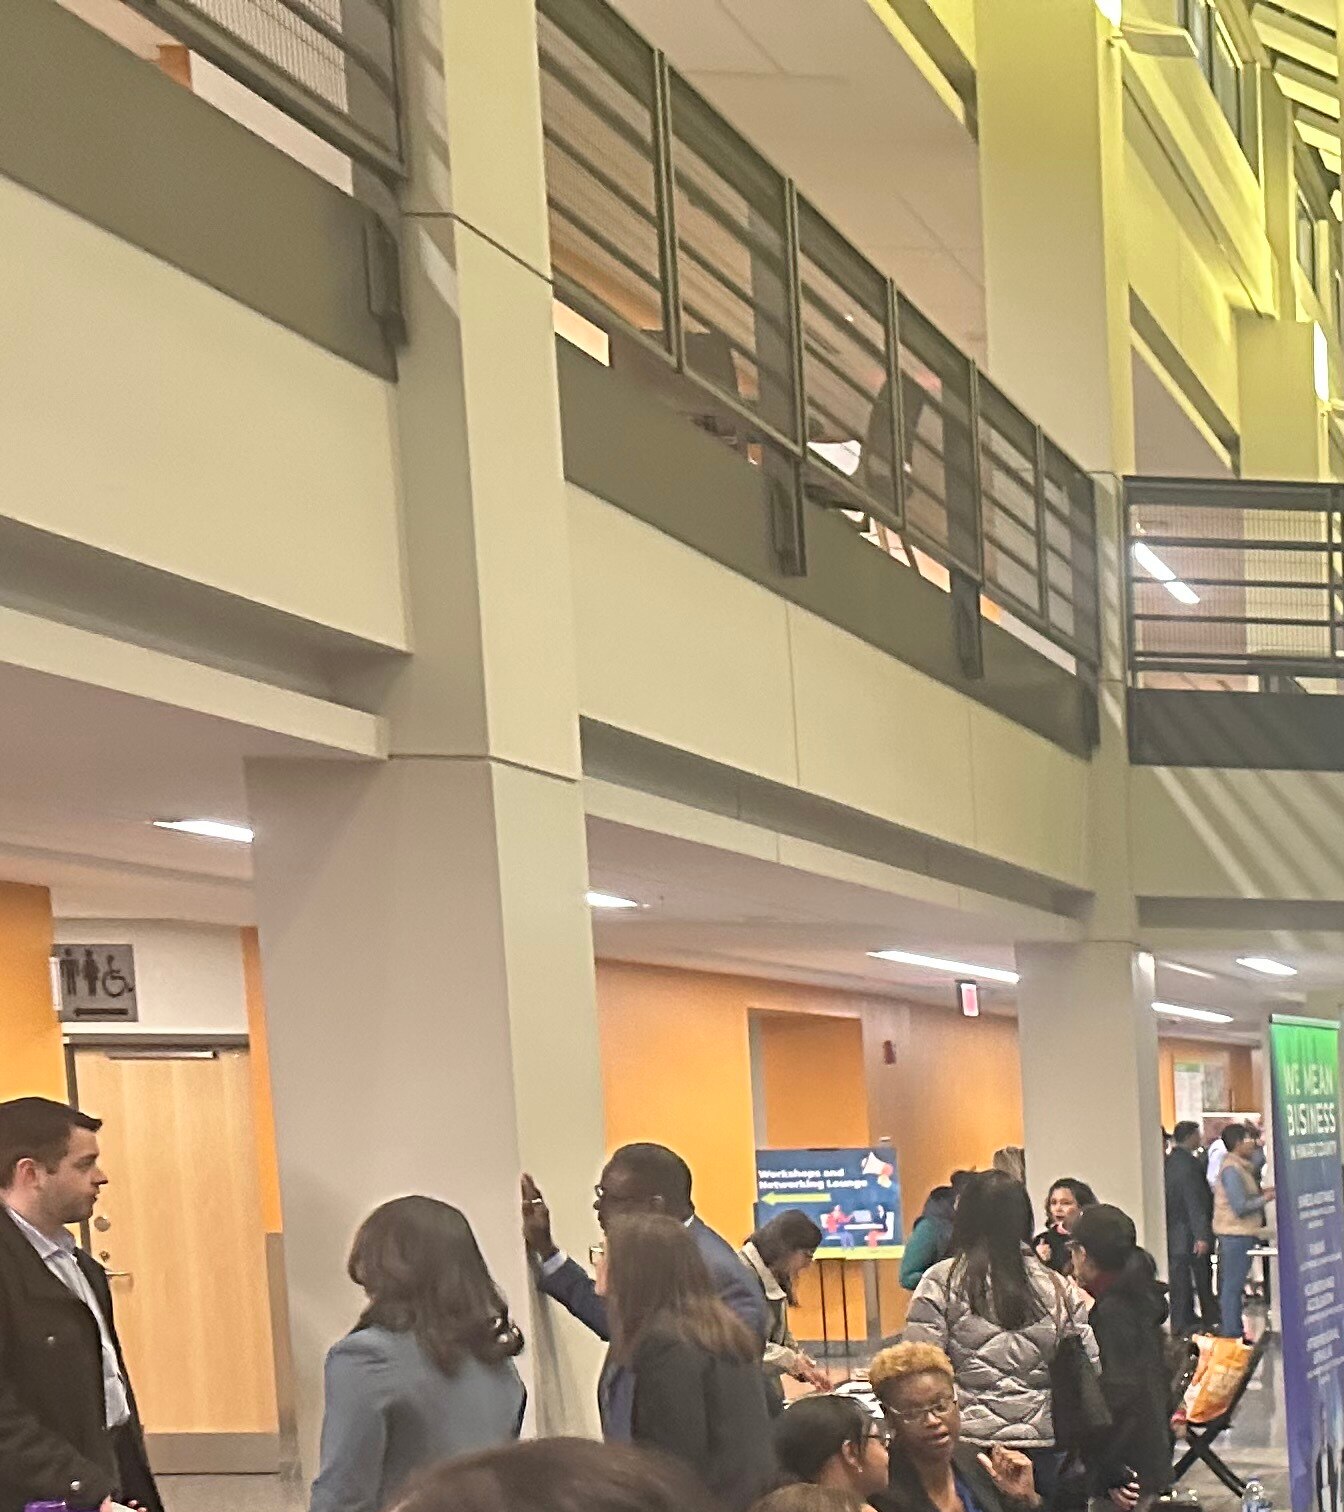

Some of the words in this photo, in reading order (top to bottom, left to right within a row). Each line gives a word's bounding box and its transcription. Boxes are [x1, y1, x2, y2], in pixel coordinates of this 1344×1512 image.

[1286, 1102, 1336, 1137] BUSINESS
[758, 1169, 821, 1179] Workshops
[824, 1168, 845, 1178] and
[759, 1179, 825, 1190] Networking
[827, 1178, 868, 1190] Lounge
